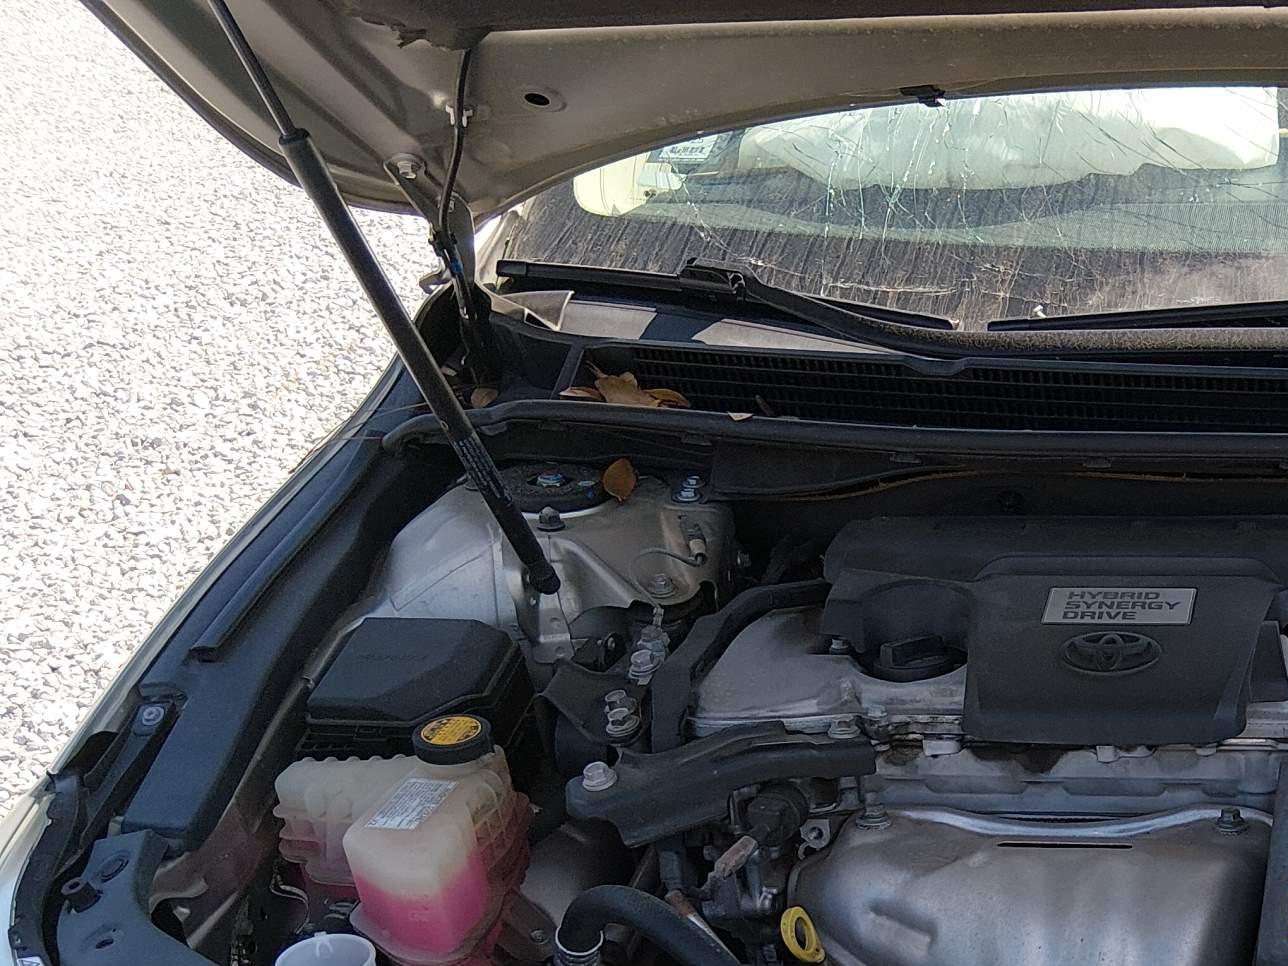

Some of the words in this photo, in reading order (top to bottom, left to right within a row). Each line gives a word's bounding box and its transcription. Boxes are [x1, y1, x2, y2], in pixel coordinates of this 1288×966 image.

[1068, 591, 1160, 600] HYBRID
[1064, 601, 1181, 610] SYNERGY
[1062, 611, 1136, 620] DRIVE
